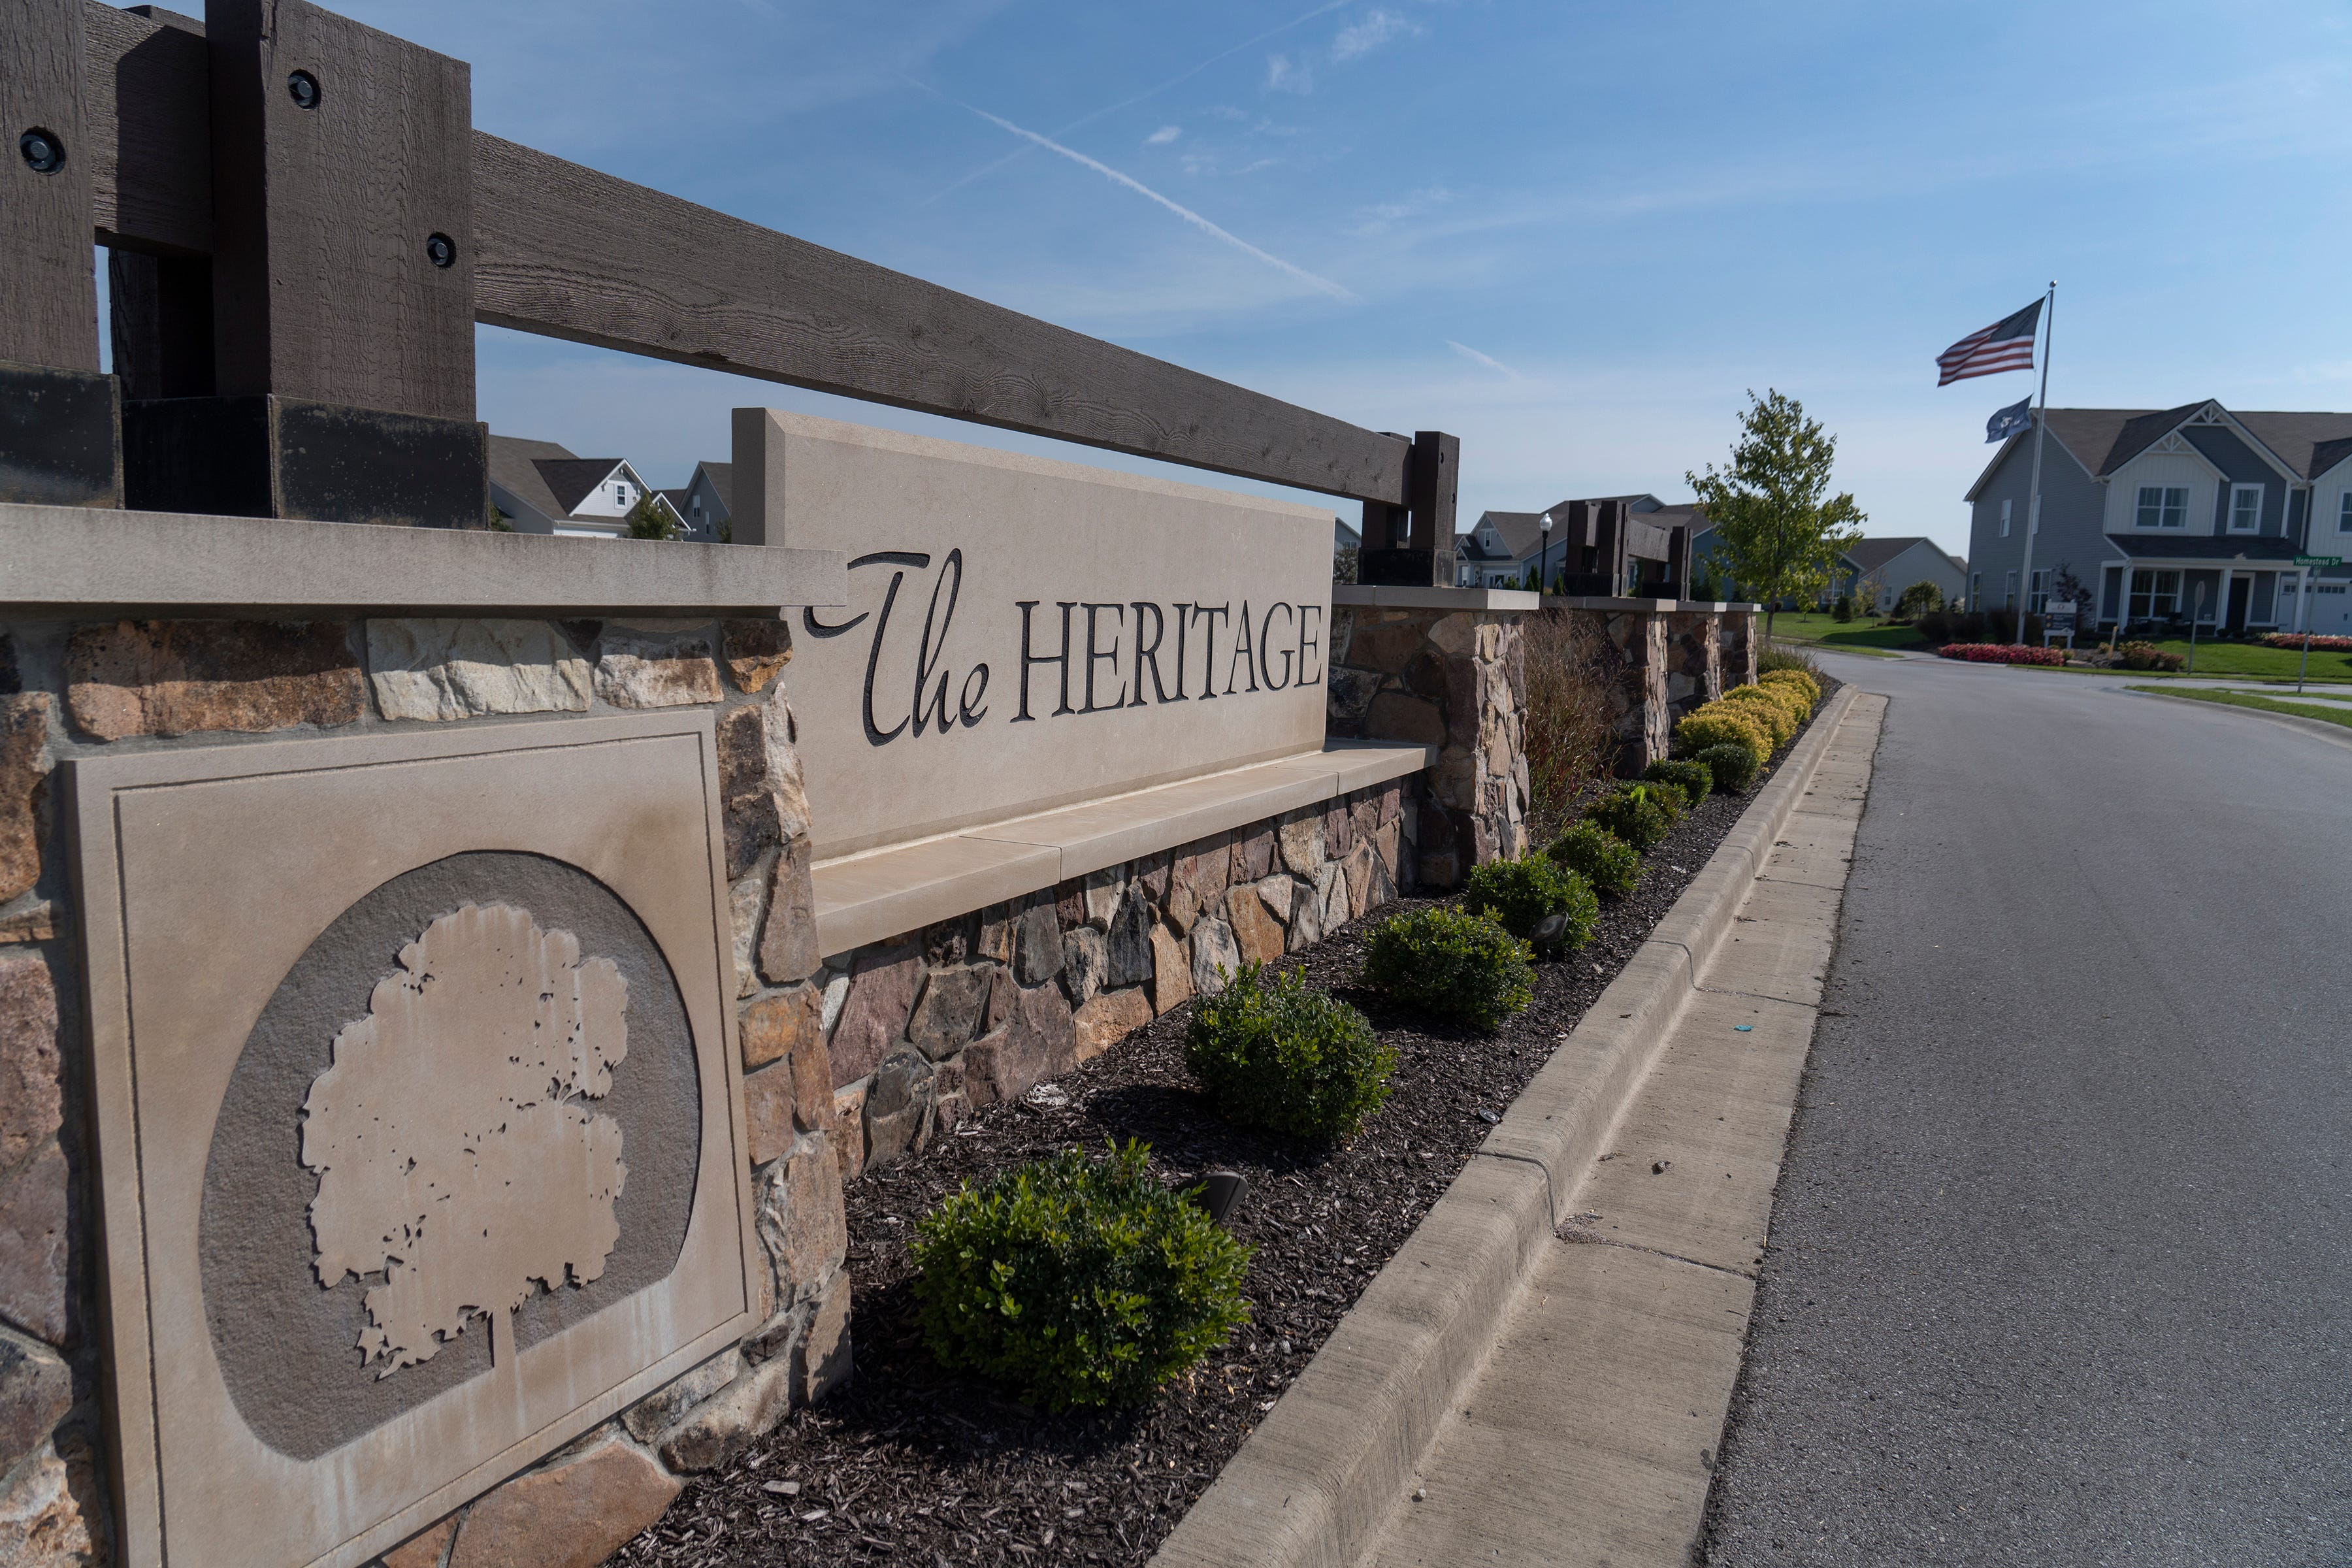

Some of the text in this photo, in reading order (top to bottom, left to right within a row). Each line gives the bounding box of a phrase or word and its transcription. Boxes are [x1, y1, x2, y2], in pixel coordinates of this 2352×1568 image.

[2295, 557, 2340, 566] Homestead Dr
[803, 548, 1322, 747] The HERITAGE
